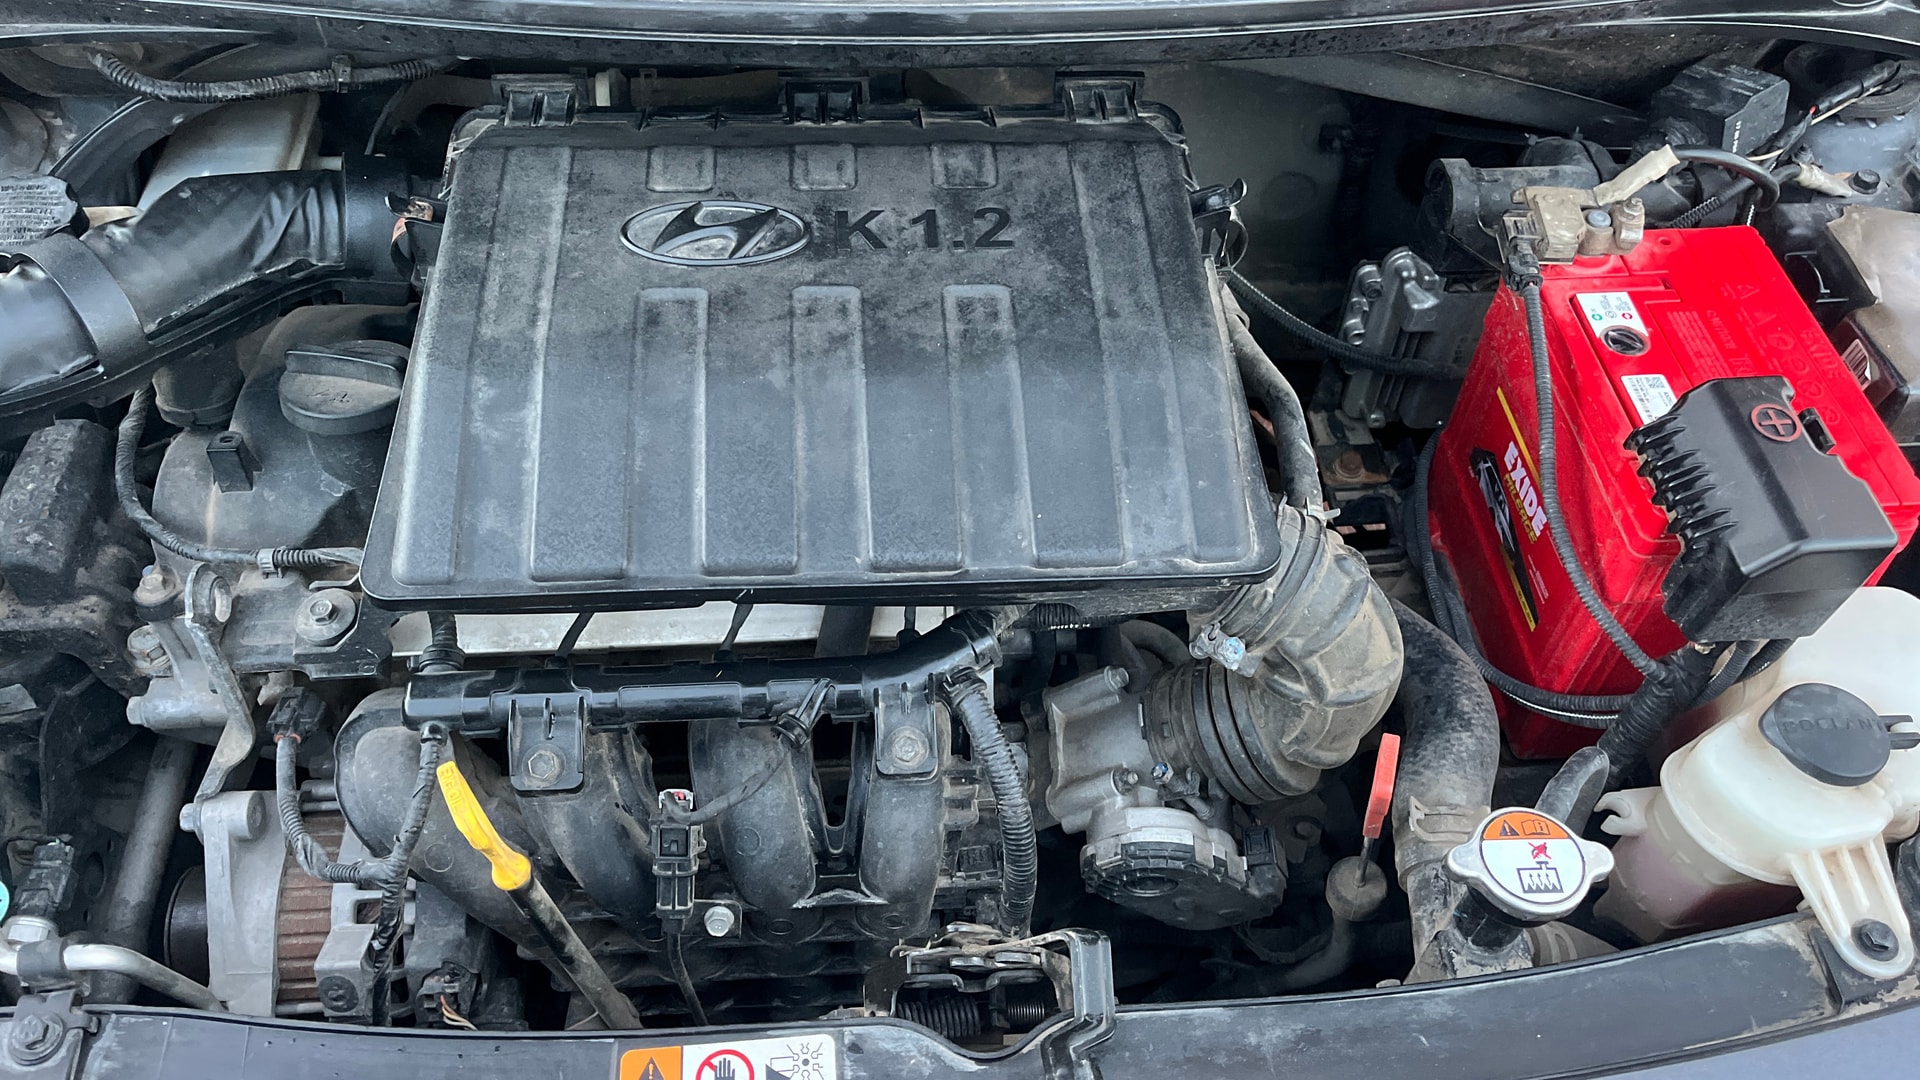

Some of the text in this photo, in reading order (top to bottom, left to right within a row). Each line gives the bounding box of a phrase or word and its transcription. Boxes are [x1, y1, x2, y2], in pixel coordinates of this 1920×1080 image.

[834, 207, 1014, 250] K 1.2
[1504, 441, 1548, 537] EXIDE
[1504, 473, 1538, 544] MILEAGE
